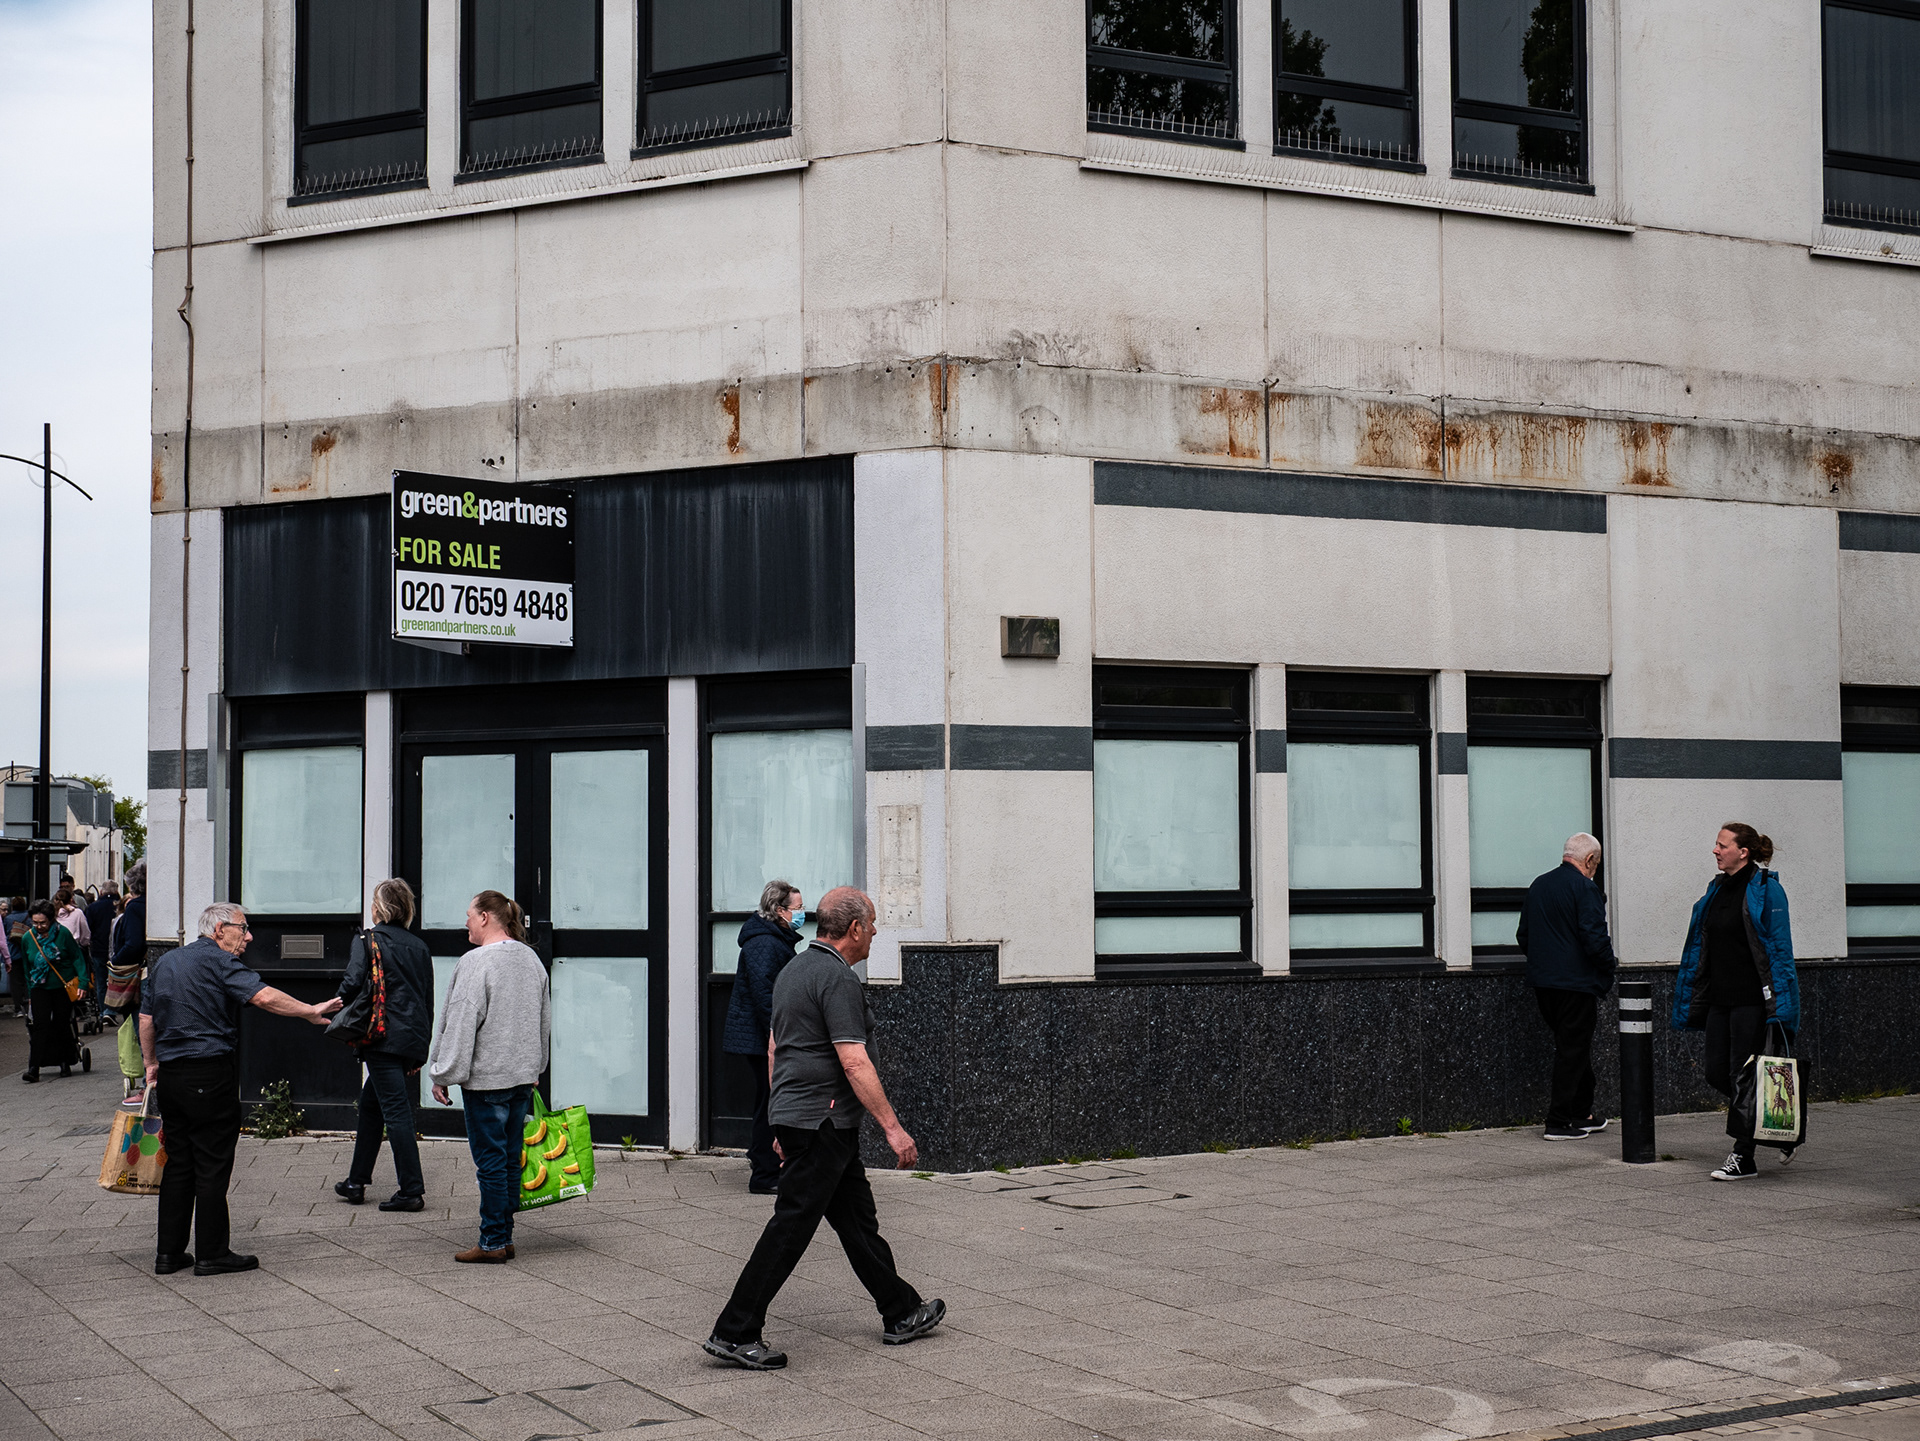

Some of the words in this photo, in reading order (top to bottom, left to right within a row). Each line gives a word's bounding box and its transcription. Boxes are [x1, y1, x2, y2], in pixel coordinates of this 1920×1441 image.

[401, 490, 568, 528] green&partners
[400, 537, 442, 565] FOR
[449, 541, 501, 570] SALE
[401, 580, 445, 613] 020
[451, 584, 507, 617] 7659
[513, 590, 568, 621] 4848
[401, 618, 516, 637] greenandpartners.co.uk
[530, 1194, 553, 1204] HOME
[562, 1187, 579, 1195] ASDA
